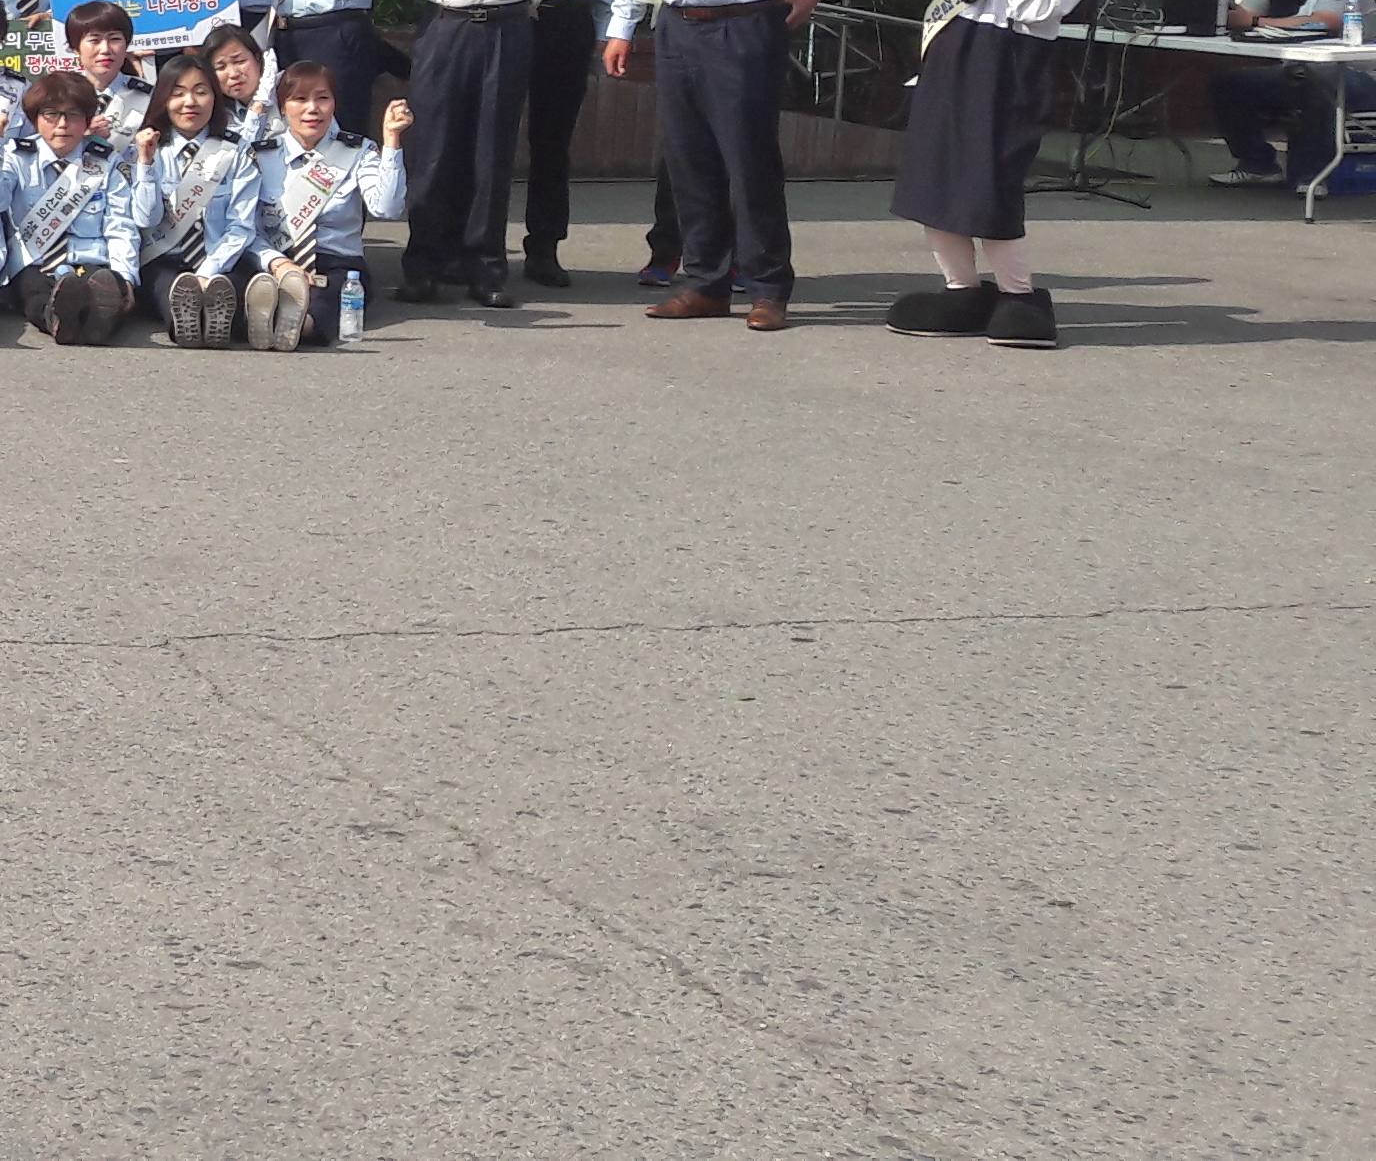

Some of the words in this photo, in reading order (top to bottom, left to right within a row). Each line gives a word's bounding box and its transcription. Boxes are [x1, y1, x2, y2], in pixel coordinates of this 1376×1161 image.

[33, 182, 68, 223] 당신의
[60, 180, 93, 218] 속도를
[287, 191, 322, 232] 안전띠
[32, 214, 64, 251] 줄이면
